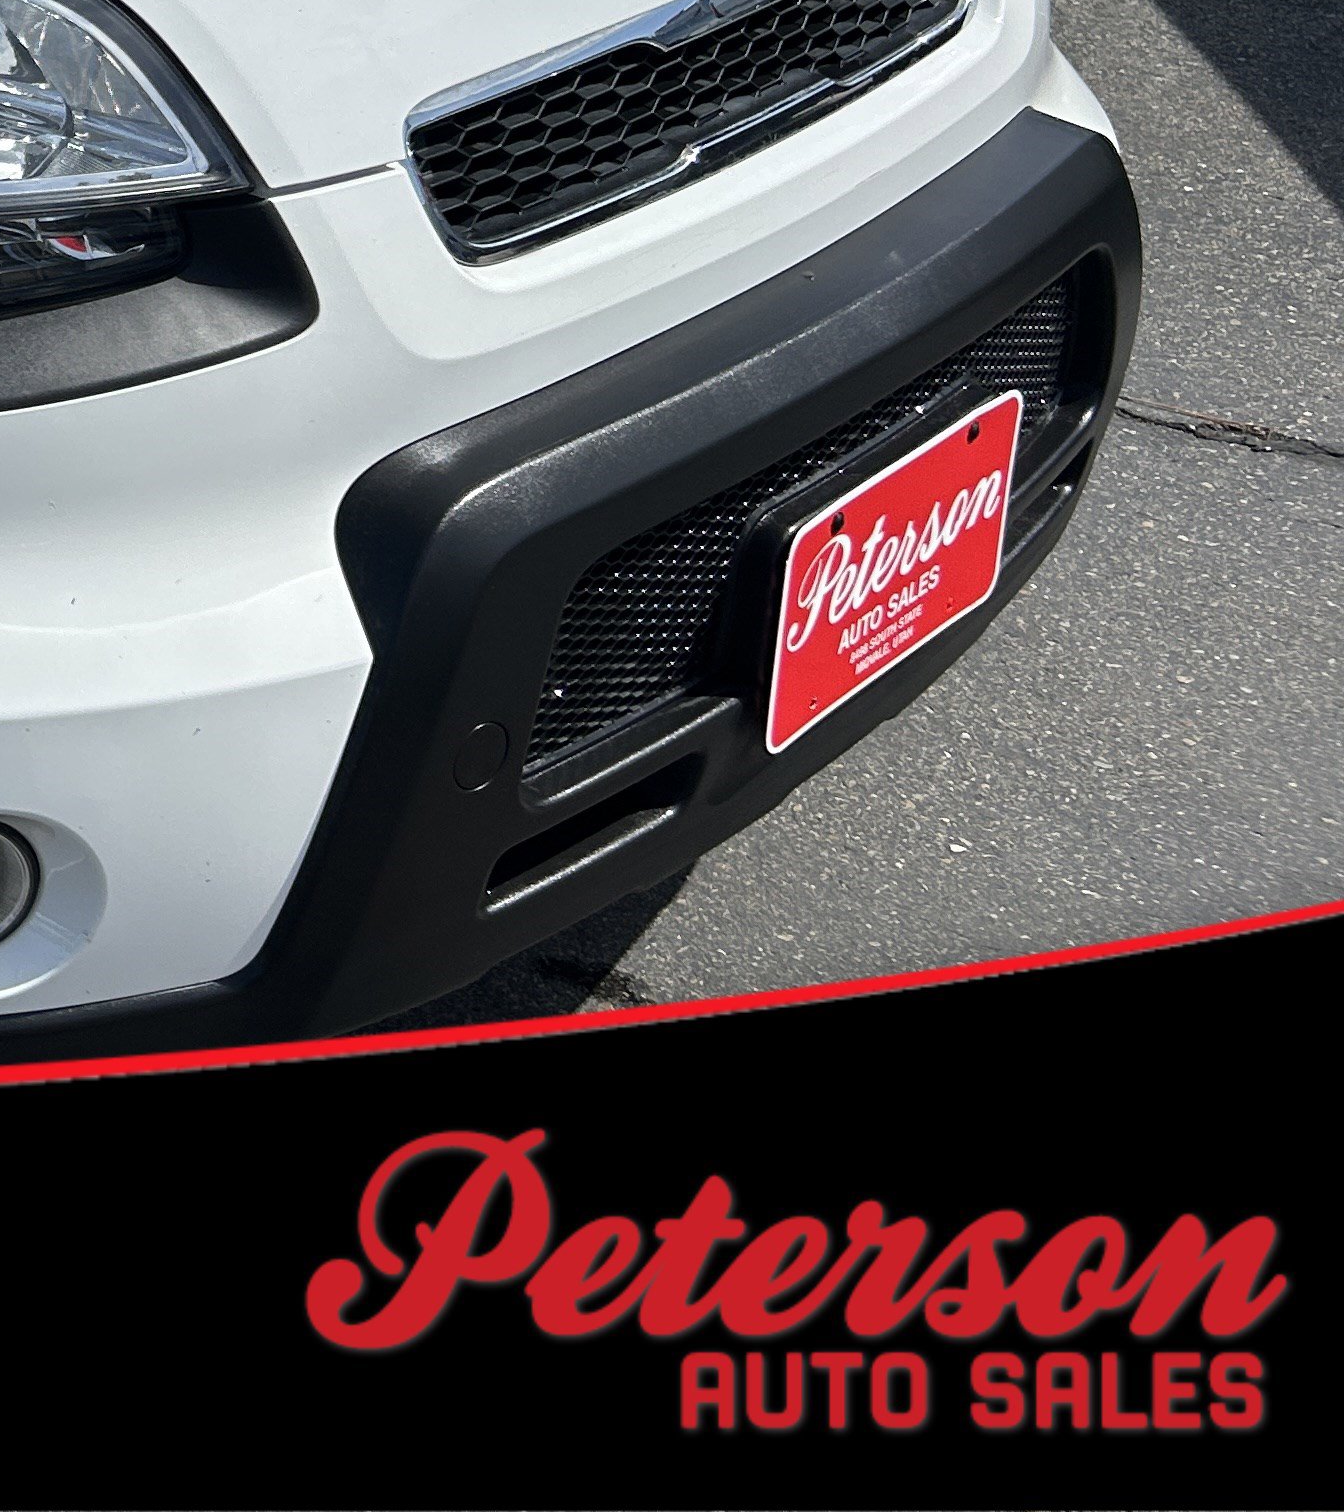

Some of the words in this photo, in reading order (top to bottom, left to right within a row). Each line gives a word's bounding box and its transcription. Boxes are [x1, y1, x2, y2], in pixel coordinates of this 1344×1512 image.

[786, 469, 1002, 652] Peterson
[837, 604, 883, 655] AUTO
[887, 565, 940, 618] SALES
